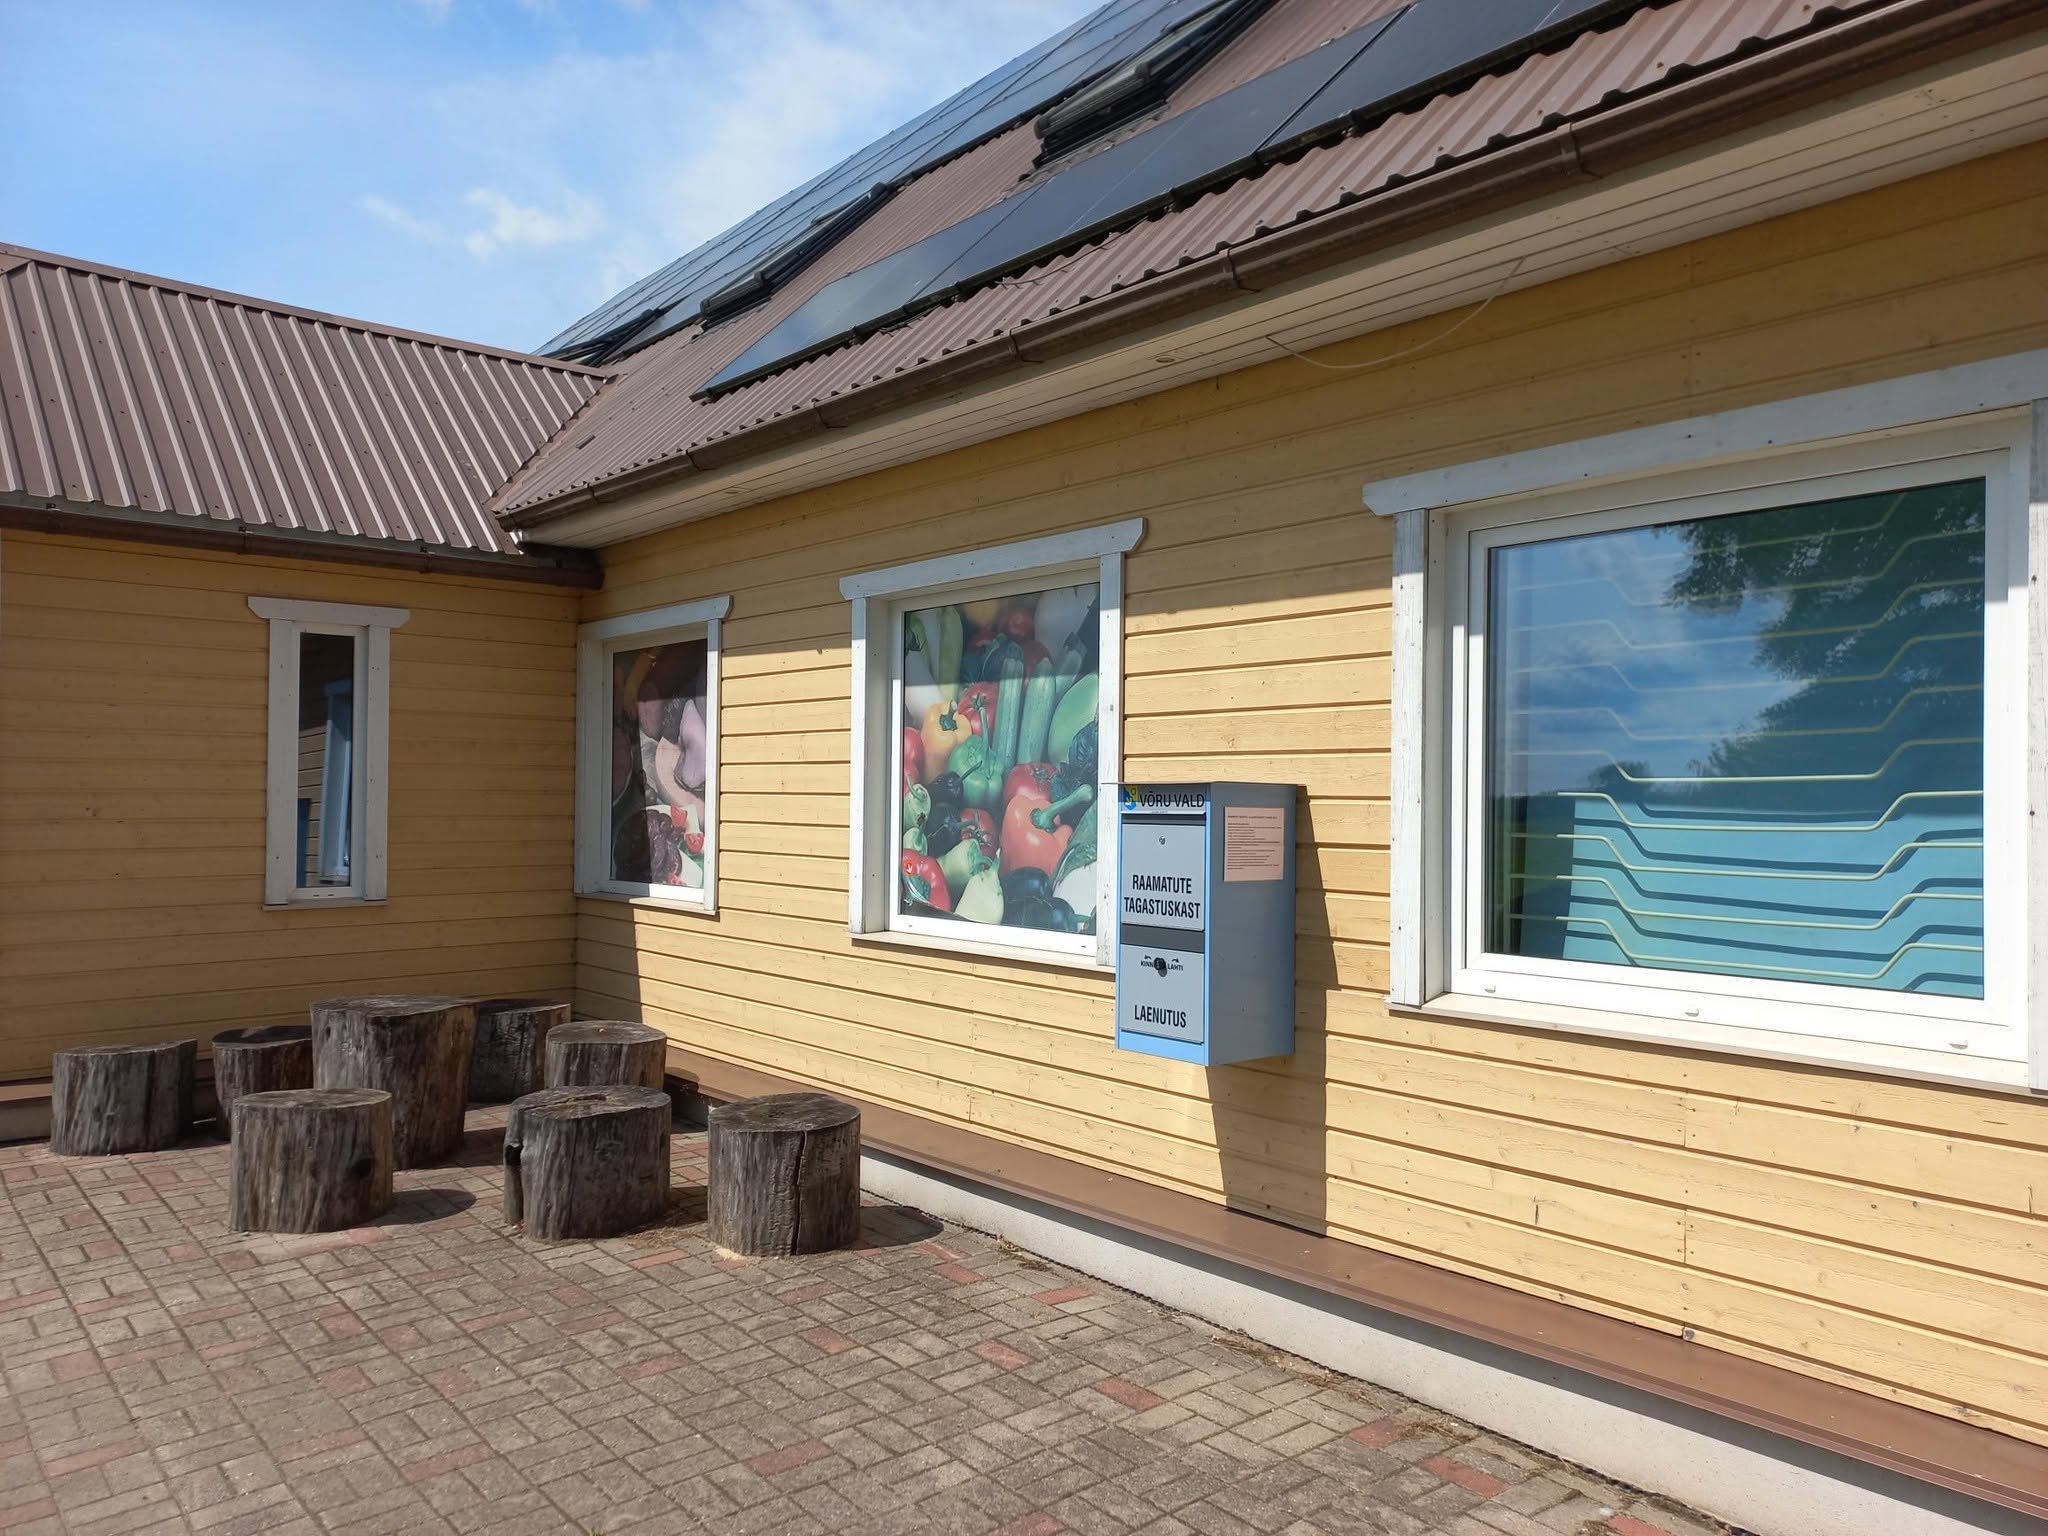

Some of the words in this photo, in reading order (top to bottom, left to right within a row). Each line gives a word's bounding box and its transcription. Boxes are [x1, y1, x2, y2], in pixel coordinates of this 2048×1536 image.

[1140, 791, 1171, 807] VÕRU
[1174, 794, 1205, 808] VALD
[1132, 874, 1192, 894] RAAMATUTE
[1124, 896, 1201, 919] TAGASTUSKAST
[1141, 960, 1155, 968] KINN
[1167, 963, 1184, 971] LAHTI
[1134, 1004, 1187, 1028] LAENUTUS
